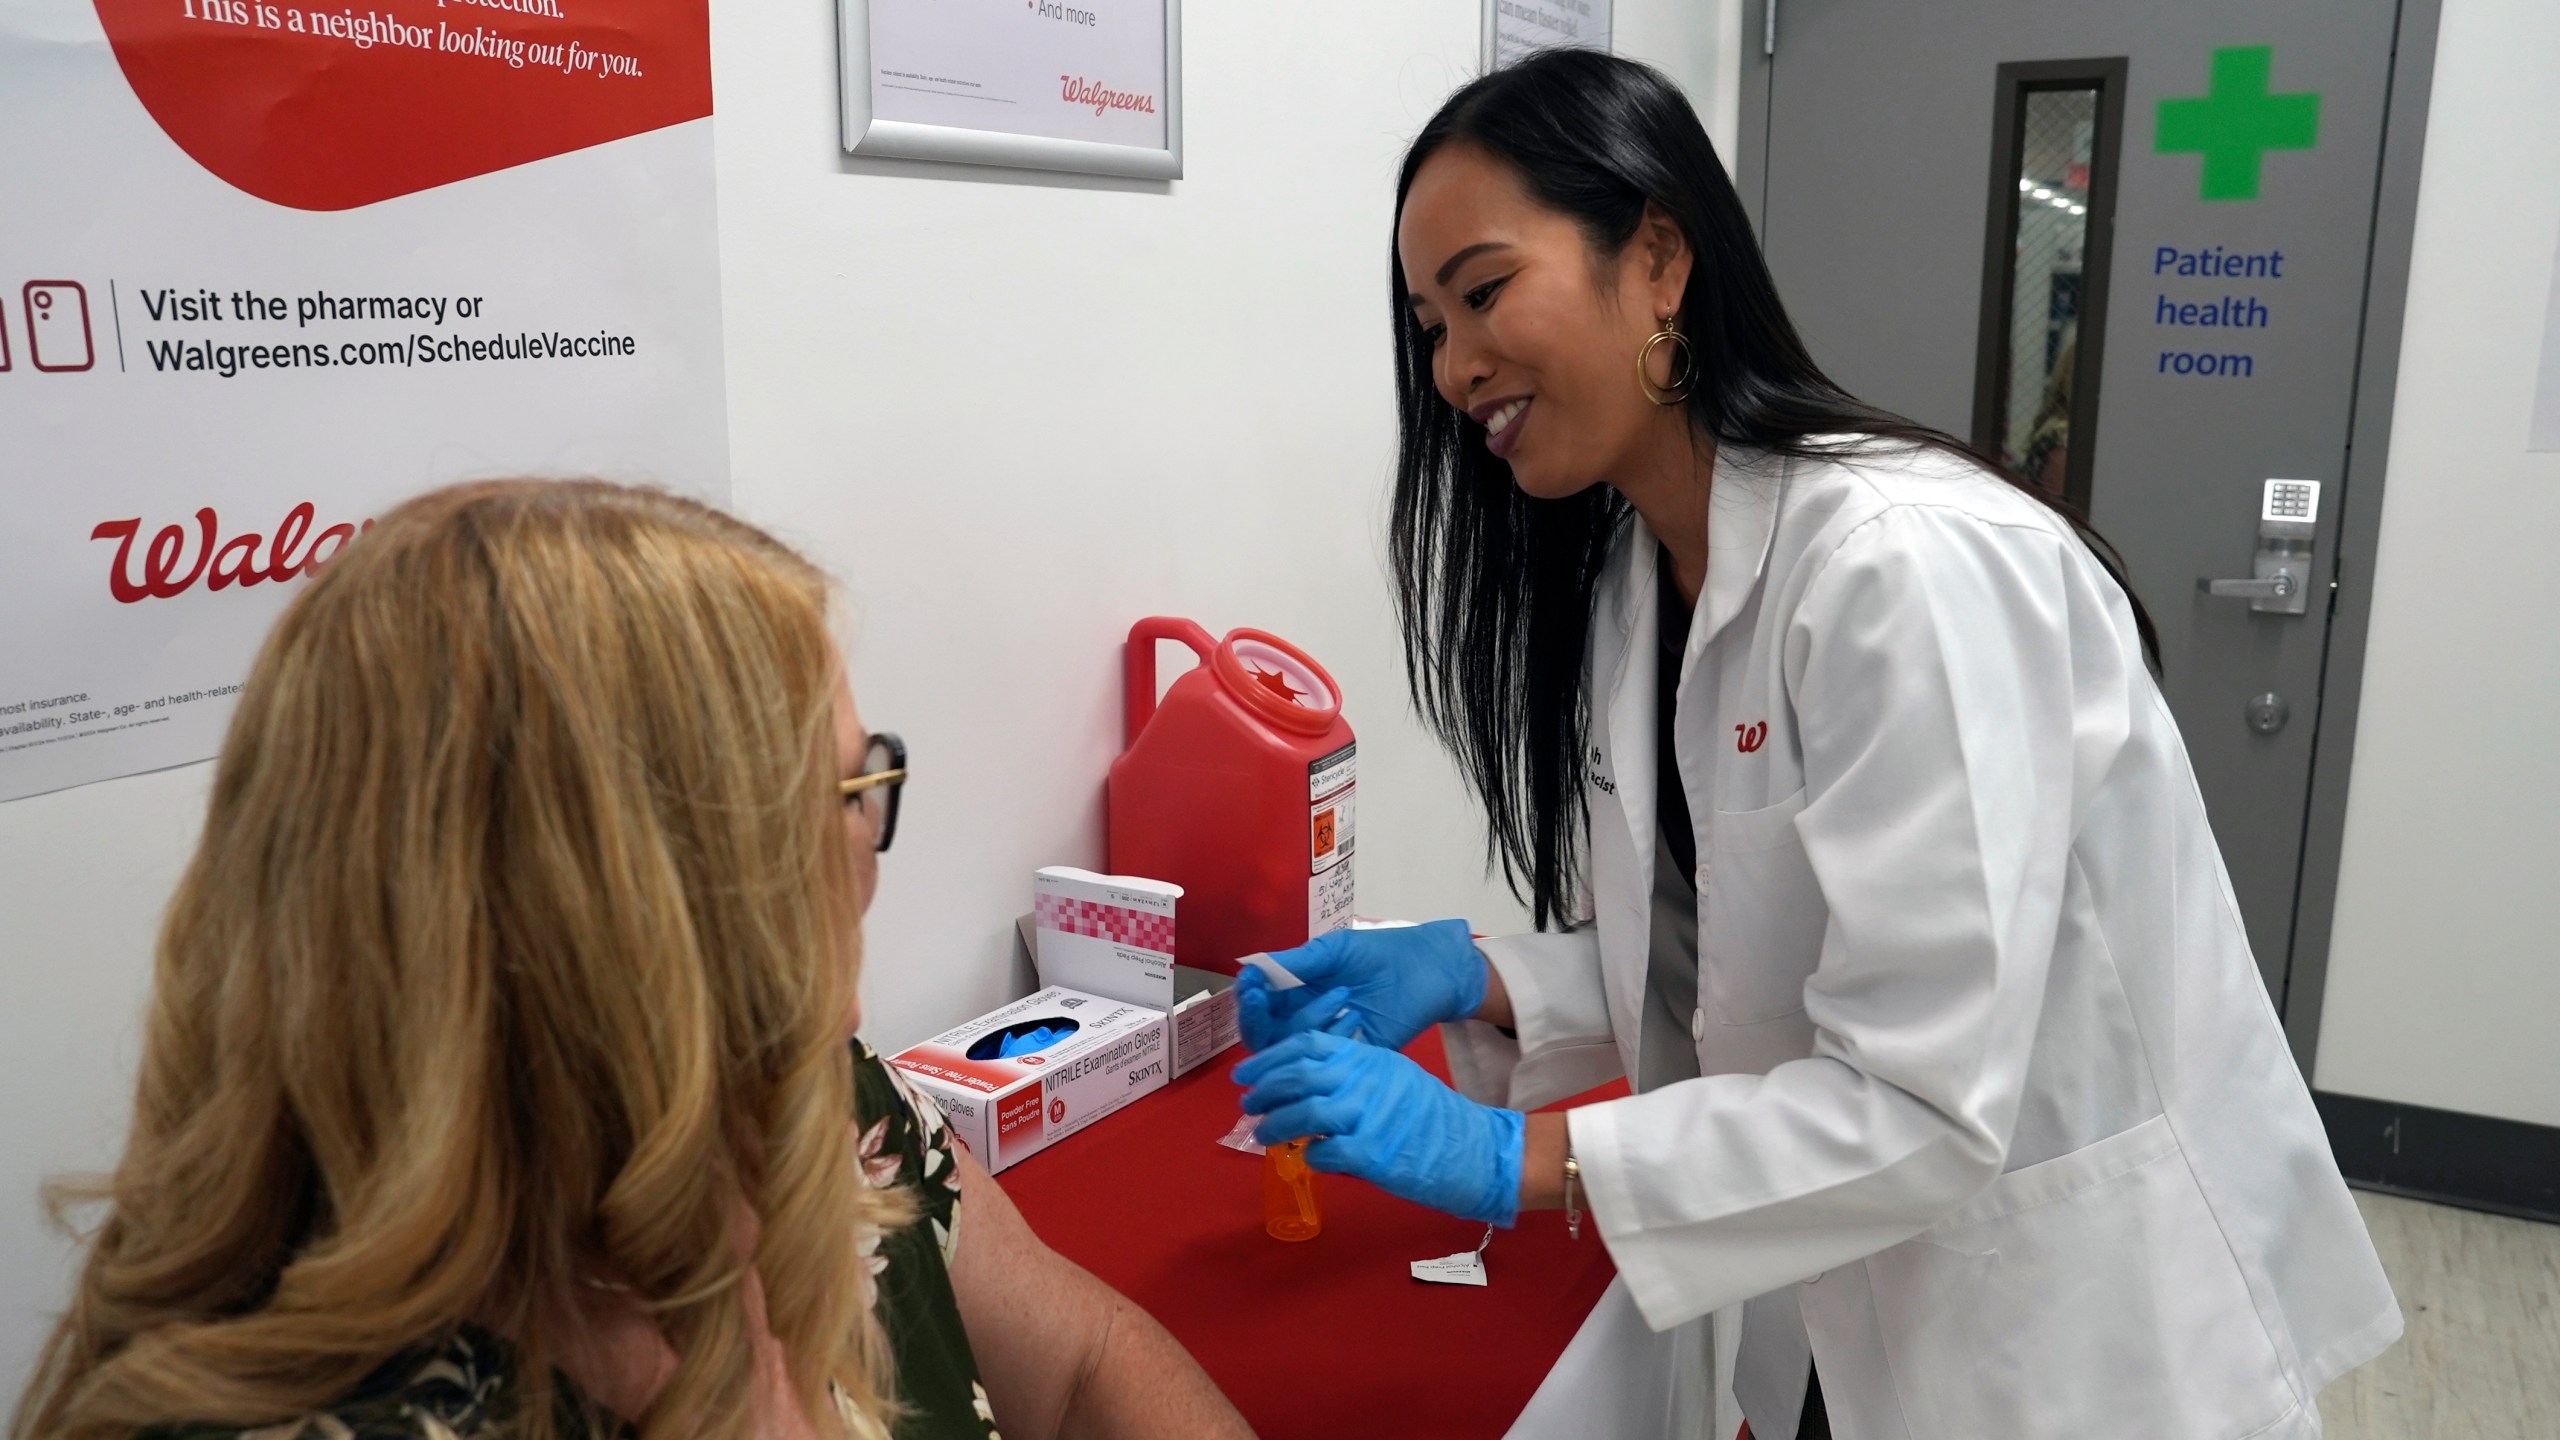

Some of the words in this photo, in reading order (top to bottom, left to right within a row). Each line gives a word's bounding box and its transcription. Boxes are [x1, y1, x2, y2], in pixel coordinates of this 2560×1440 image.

[1038, 1, 1062, 20] And
[1066, 8, 1096, 27] more
[255, 0, 281, 29] is
[287, 8, 306, 33] a
[310, 9, 433, 49] neighbor
[438, 22, 525, 68] looking
[528, 41, 564, 66] out
[562, 40, 599, 74] for
[598, 52, 643, 78] you.
[1061, 74, 1155, 116] Walgreens
[2155, 246, 2284, 278] Patient
[140, 289, 222, 322] Visit
[231, 290, 288, 321] the
[298, 290, 448, 328] pharmacy
[455, 297, 483, 318] or
[2156, 294, 2268, 328] health
[146, 330, 636, 378] Walgreens.com/ScheduleVaccine
[2159, 352, 2254, 377] room
[29, 693, 91, 711] insurance.
[69, 710, 111, 724] State-,
[113, 703, 140, 717] age-
[144, 696, 166, 710] and
[1591, 772, 1615, 795] acist
[919, 1064, 942, 1074] Sans
[1045, 1060, 1082, 1094] NITRILE
[1084, 1043, 1133, 1075] Examination
[1134, 1027, 1160, 1051] Gloves
[1105, 1062, 1119, 1075] Gants
[1142, 1041, 1160, 1058] NITRILE
[945, 1070, 967, 1081] Free
[965, 1076, 999, 1092] Powder
[1128, 1060, 1163, 1086] SKINTX
[949, 1098, 975, 1118] Gloves
[1001, 1104, 1024, 1121] Powder
[1025, 1096, 1039, 1109] Free
[1001, 1120, 1017, 1133] Sans
[1018, 1108, 1040, 1125] Poudre
[1054, 1103, 1061, 1114] M
